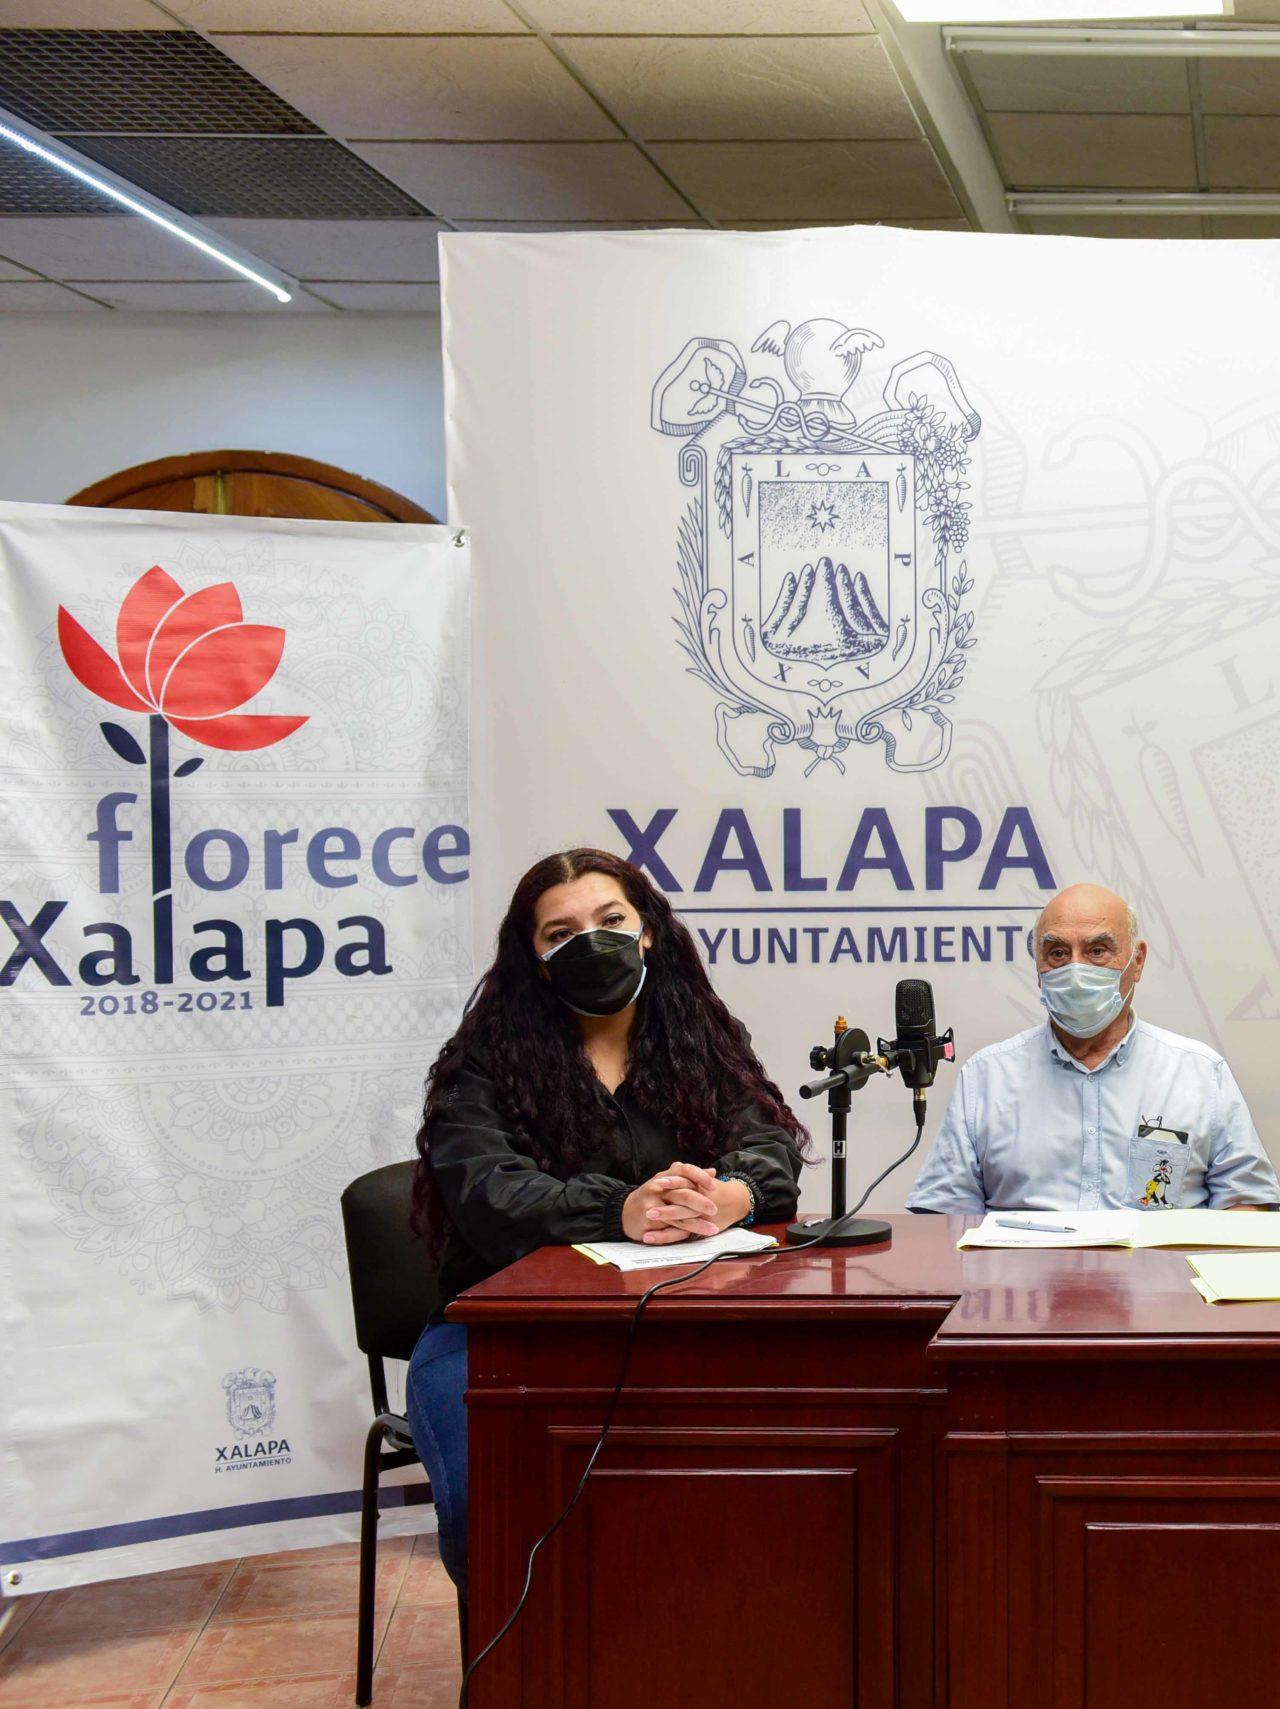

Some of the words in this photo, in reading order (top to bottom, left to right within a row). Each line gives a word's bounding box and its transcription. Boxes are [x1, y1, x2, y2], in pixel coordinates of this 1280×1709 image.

[87, 791, 471, 894] florece
[605, 807, 1057, 892] XALAPA
[0, 894, 393, 1007] Xalapa
[697, 925, 1035, 965] YUNTAMIENT
[80, 990, 254, 1016] 2018-2021
[215, 1439, 291, 1462] XALAPA
[226, 1457, 291, 1472] AYUNTAMIENTO
